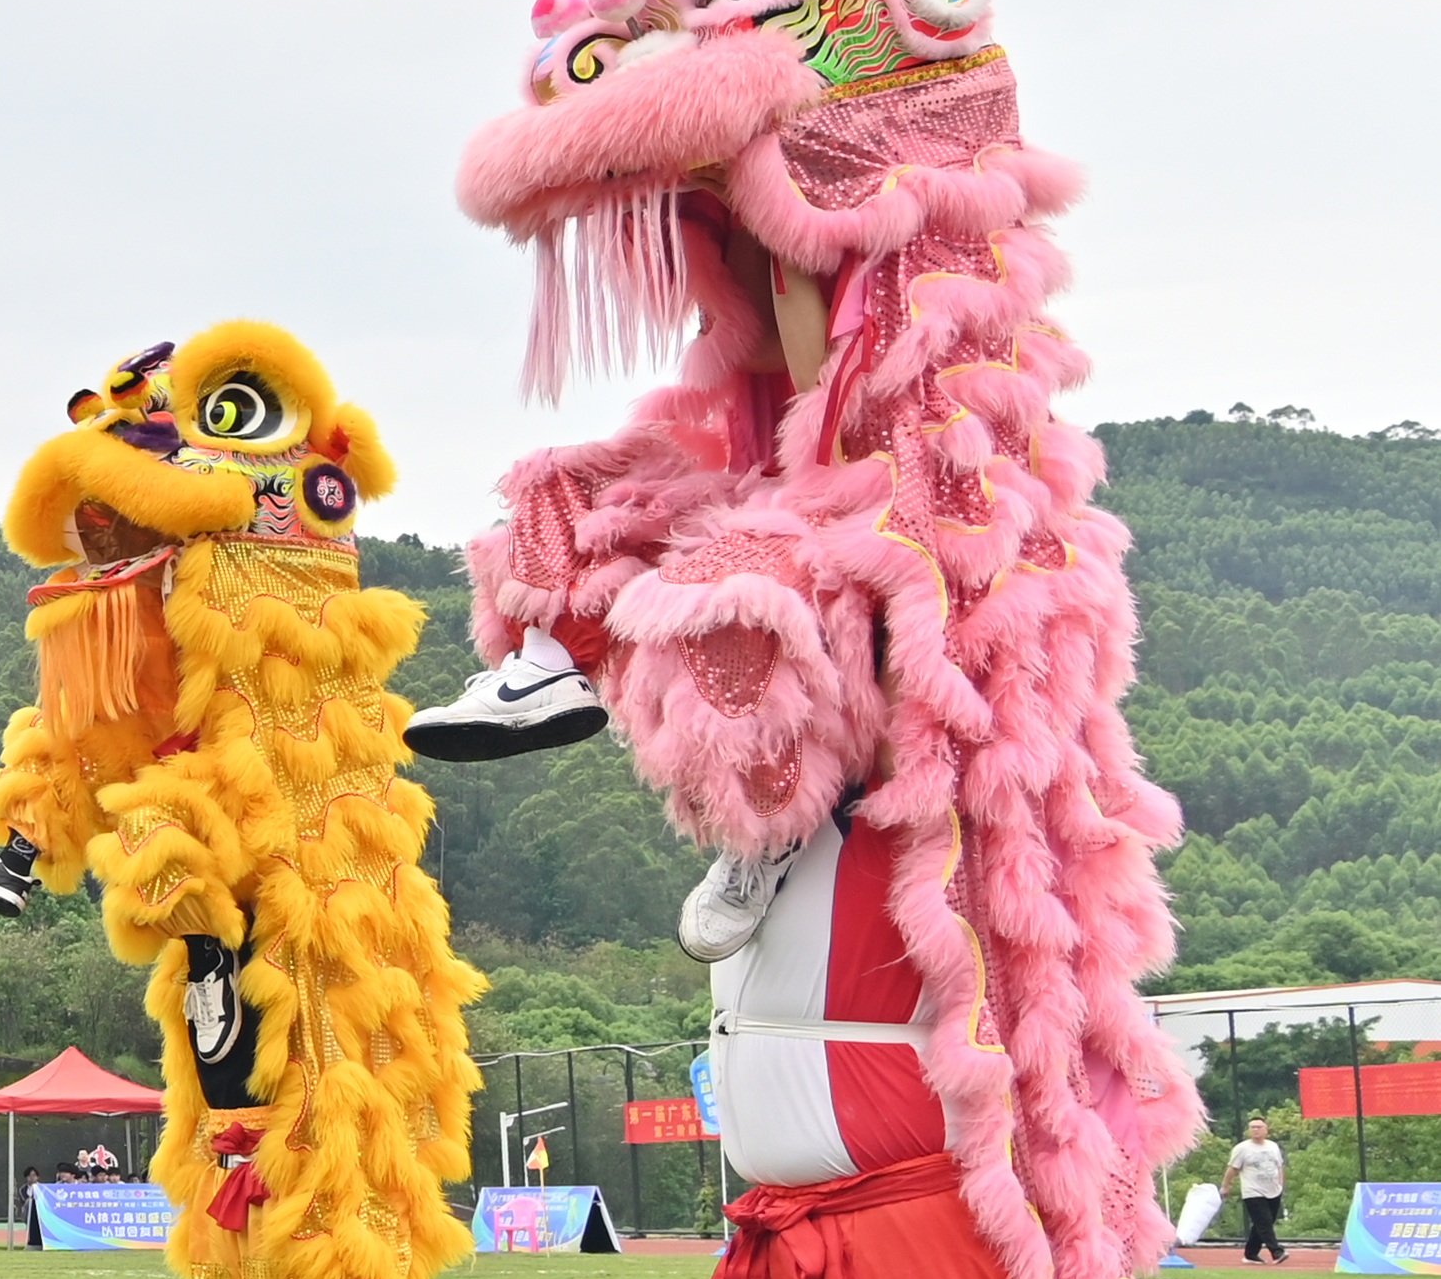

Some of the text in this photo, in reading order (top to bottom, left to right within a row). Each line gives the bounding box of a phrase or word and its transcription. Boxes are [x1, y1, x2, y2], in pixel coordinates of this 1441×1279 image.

[101, 1225, 168, 1238] 以球会友聚
